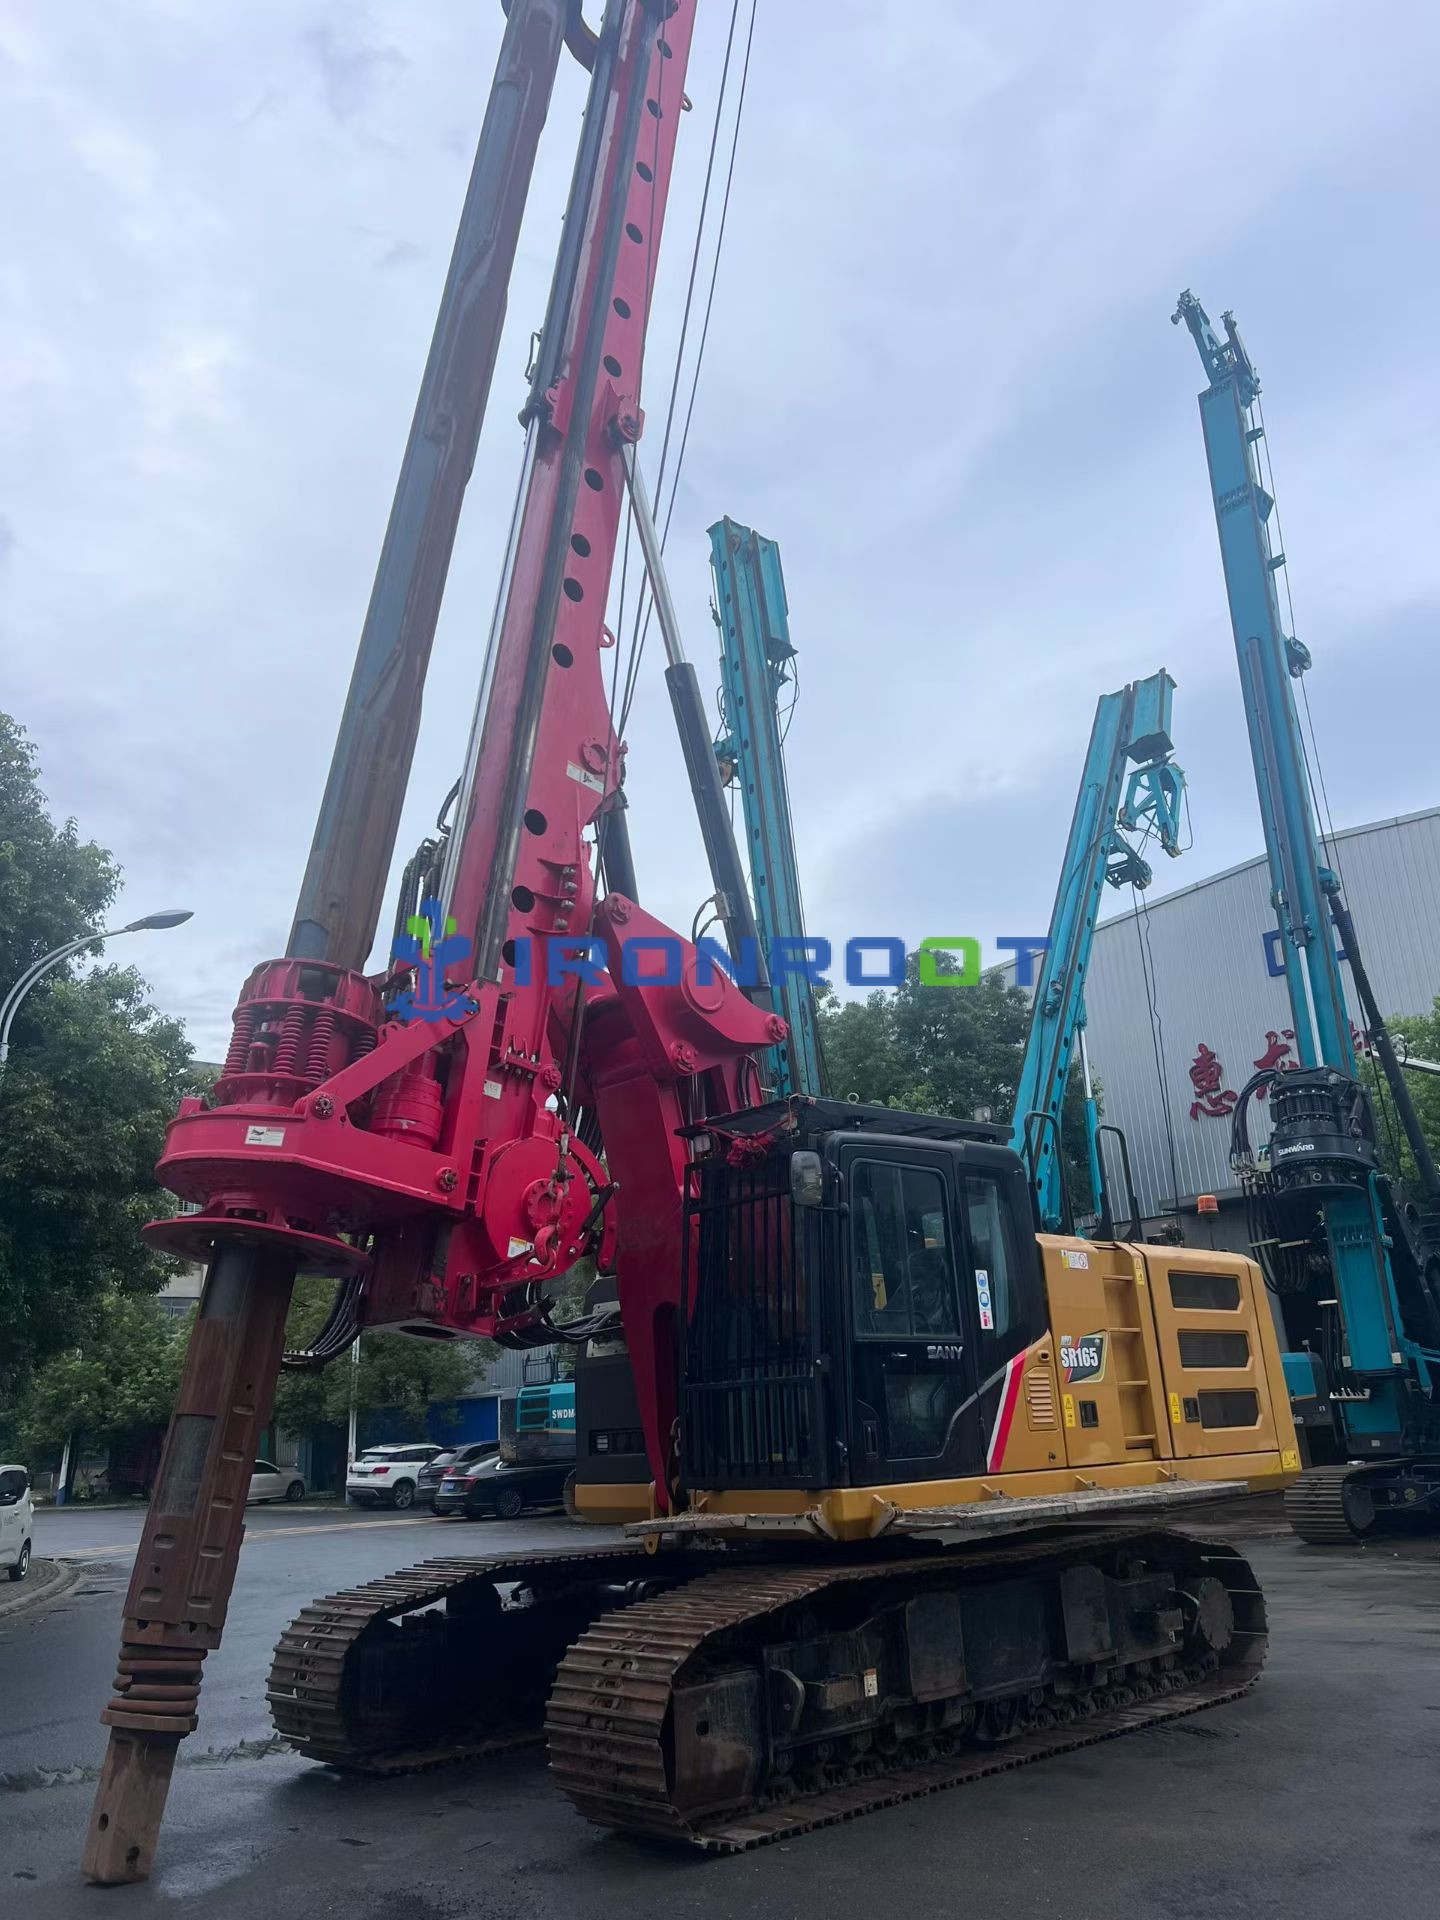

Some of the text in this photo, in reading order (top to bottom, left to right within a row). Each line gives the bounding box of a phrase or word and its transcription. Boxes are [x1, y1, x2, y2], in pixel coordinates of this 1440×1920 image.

[1278, 1142, 1315, 1156] SUNWARD
[927, 1345, 963, 1360] SANY
[1060, 1347, 1099, 1368] SR165
